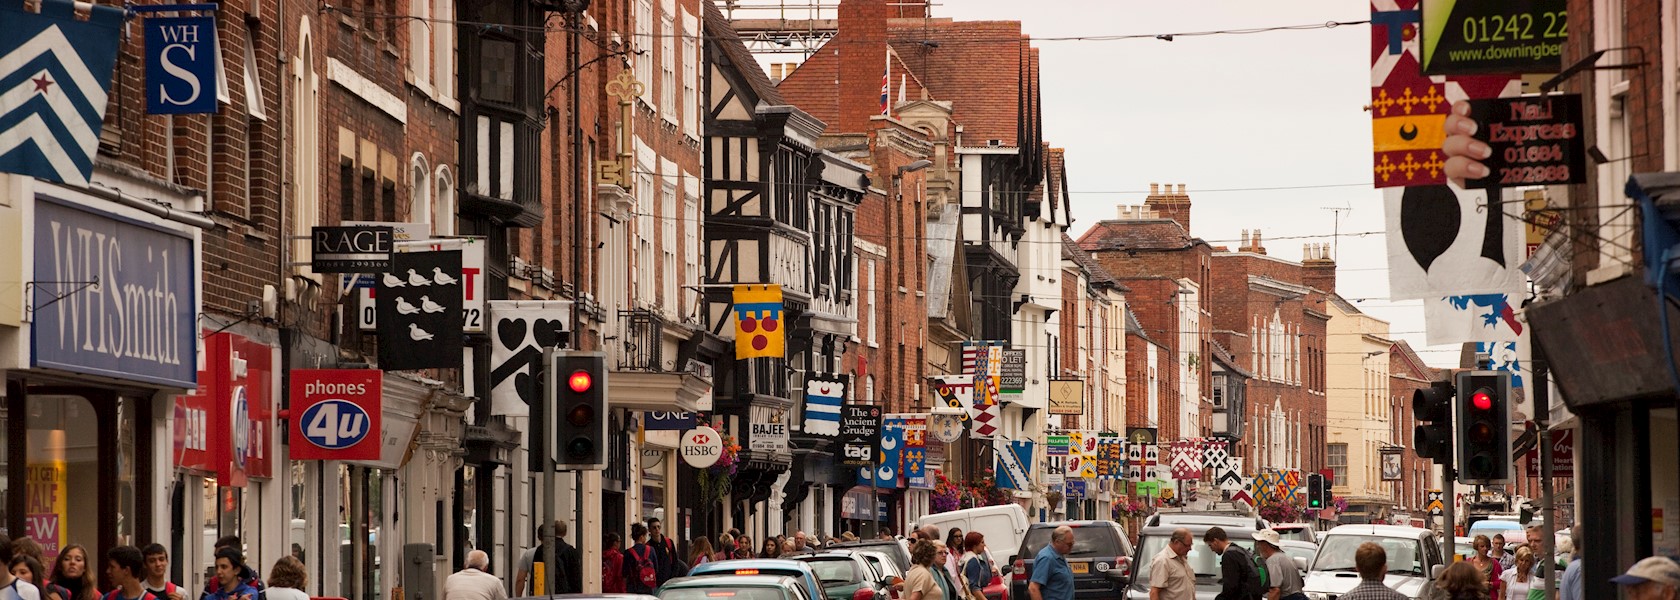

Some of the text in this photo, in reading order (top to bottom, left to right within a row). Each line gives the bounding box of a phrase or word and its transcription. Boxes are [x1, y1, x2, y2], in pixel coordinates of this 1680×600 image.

[159, 25, 199, 43] WH
[1463, 13, 1534, 43] 01242
[160, 44, 201, 106] S
[1489, 122, 1576, 145] Express
[1504, 144, 1562, 162] 01684
[1499, 165, 1569, 183] 292988
[315, 230, 390, 252] RAGE
[50, 221, 181, 364] WHSmith
[305, 379, 366, 398] phones
[844, 417, 876, 426] Ancient
[849, 408, 868, 417] The
[307, 403, 364, 446] 4u
[752, 424, 784, 435] BAJEE
[843, 426, 875, 437] Grudge
[685, 446, 718, 456] HSBC
[844, 443, 872, 461] tag
[26, 517, 57, 540] EW
[1097, 563, 1108, 571] GB
